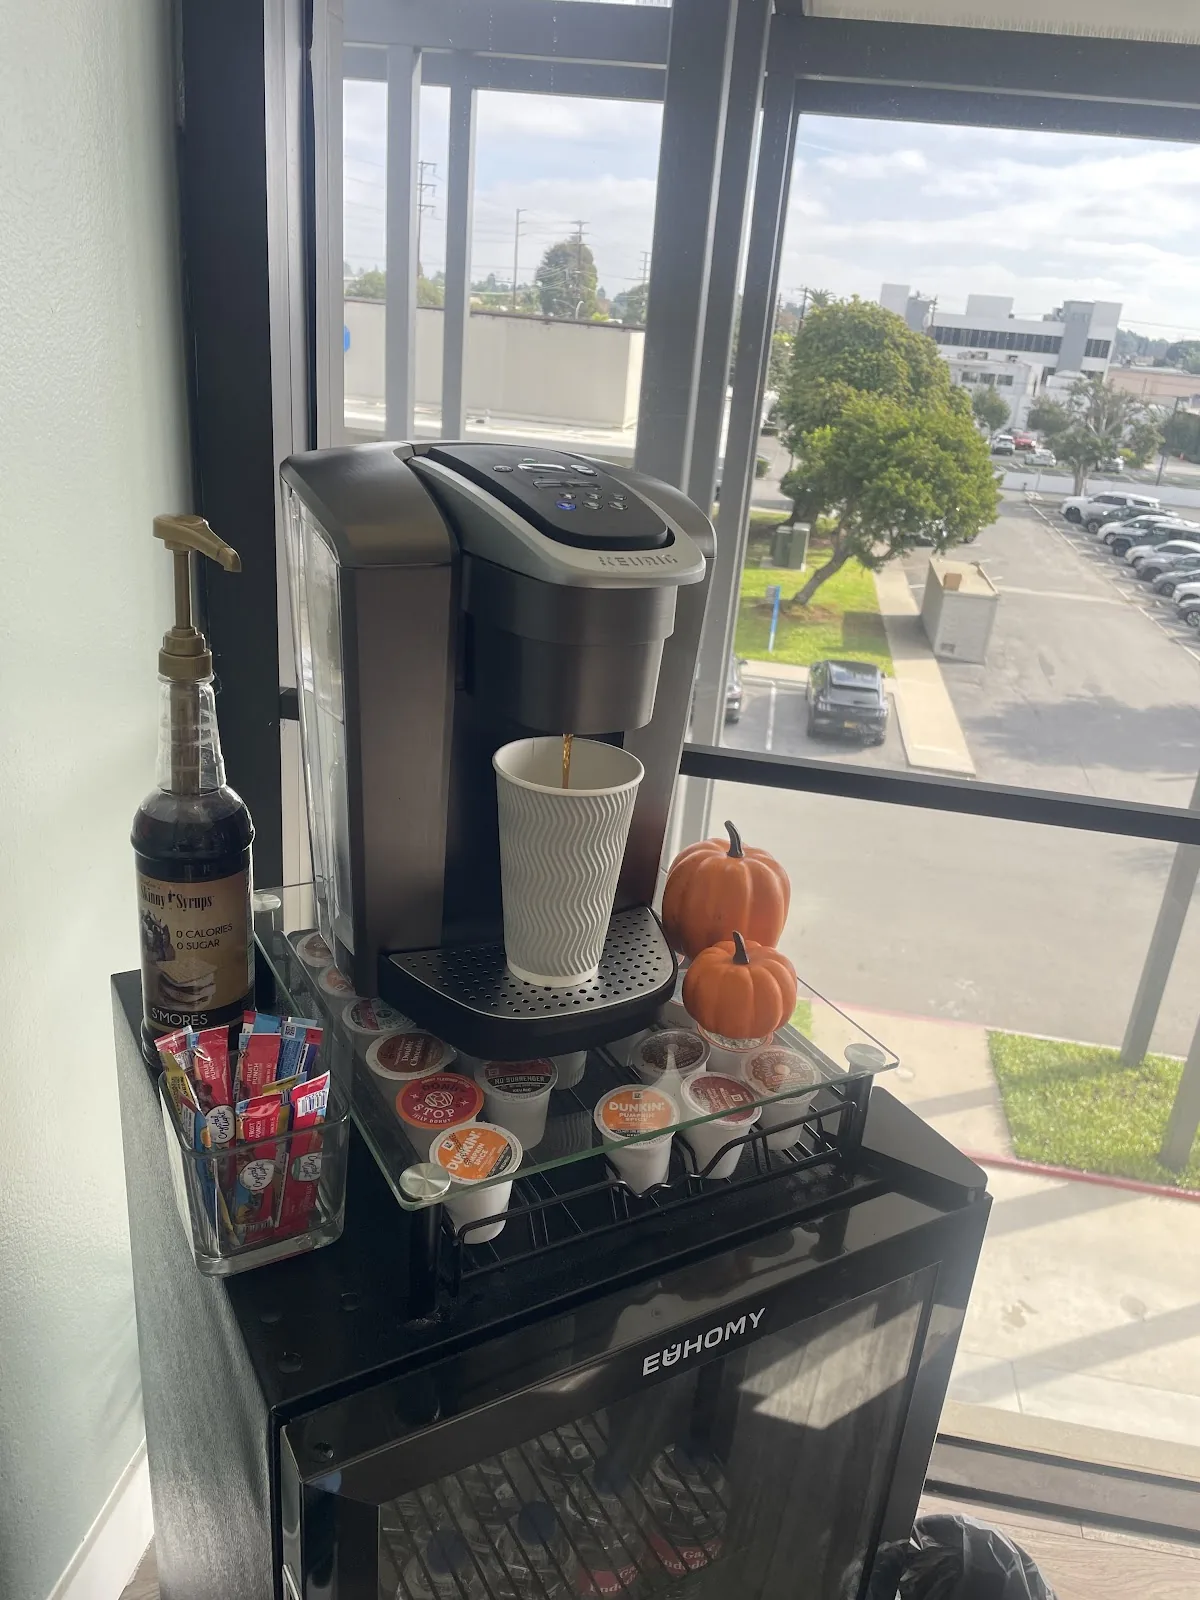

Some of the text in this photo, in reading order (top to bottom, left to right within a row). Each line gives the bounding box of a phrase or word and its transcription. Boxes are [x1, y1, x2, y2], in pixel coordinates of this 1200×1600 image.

[598, 554, 678, 566] KEURIG
[140, 885, 212, 912] Skinny Syrups
[176, 923, 233, 939] 0 CALORIES
[176, 939, 220, 950] 0 SUGAR
[152, 1007, 208, 1026] S'MORES
[401, 1041, 415, 1062] Double
[202, 1060, 211, 1079] FRUIT
[252, 1063, 260, 1085] PUNCH
[412, 1113, 428, 1123] JELLY
[413, 1103, 455, 1119] STOP
[210, 1115, 229, 1140] Crystal
[473, 1149, 489, 1166] SPICE
[246, 1166, 267, 1188] Crystal
